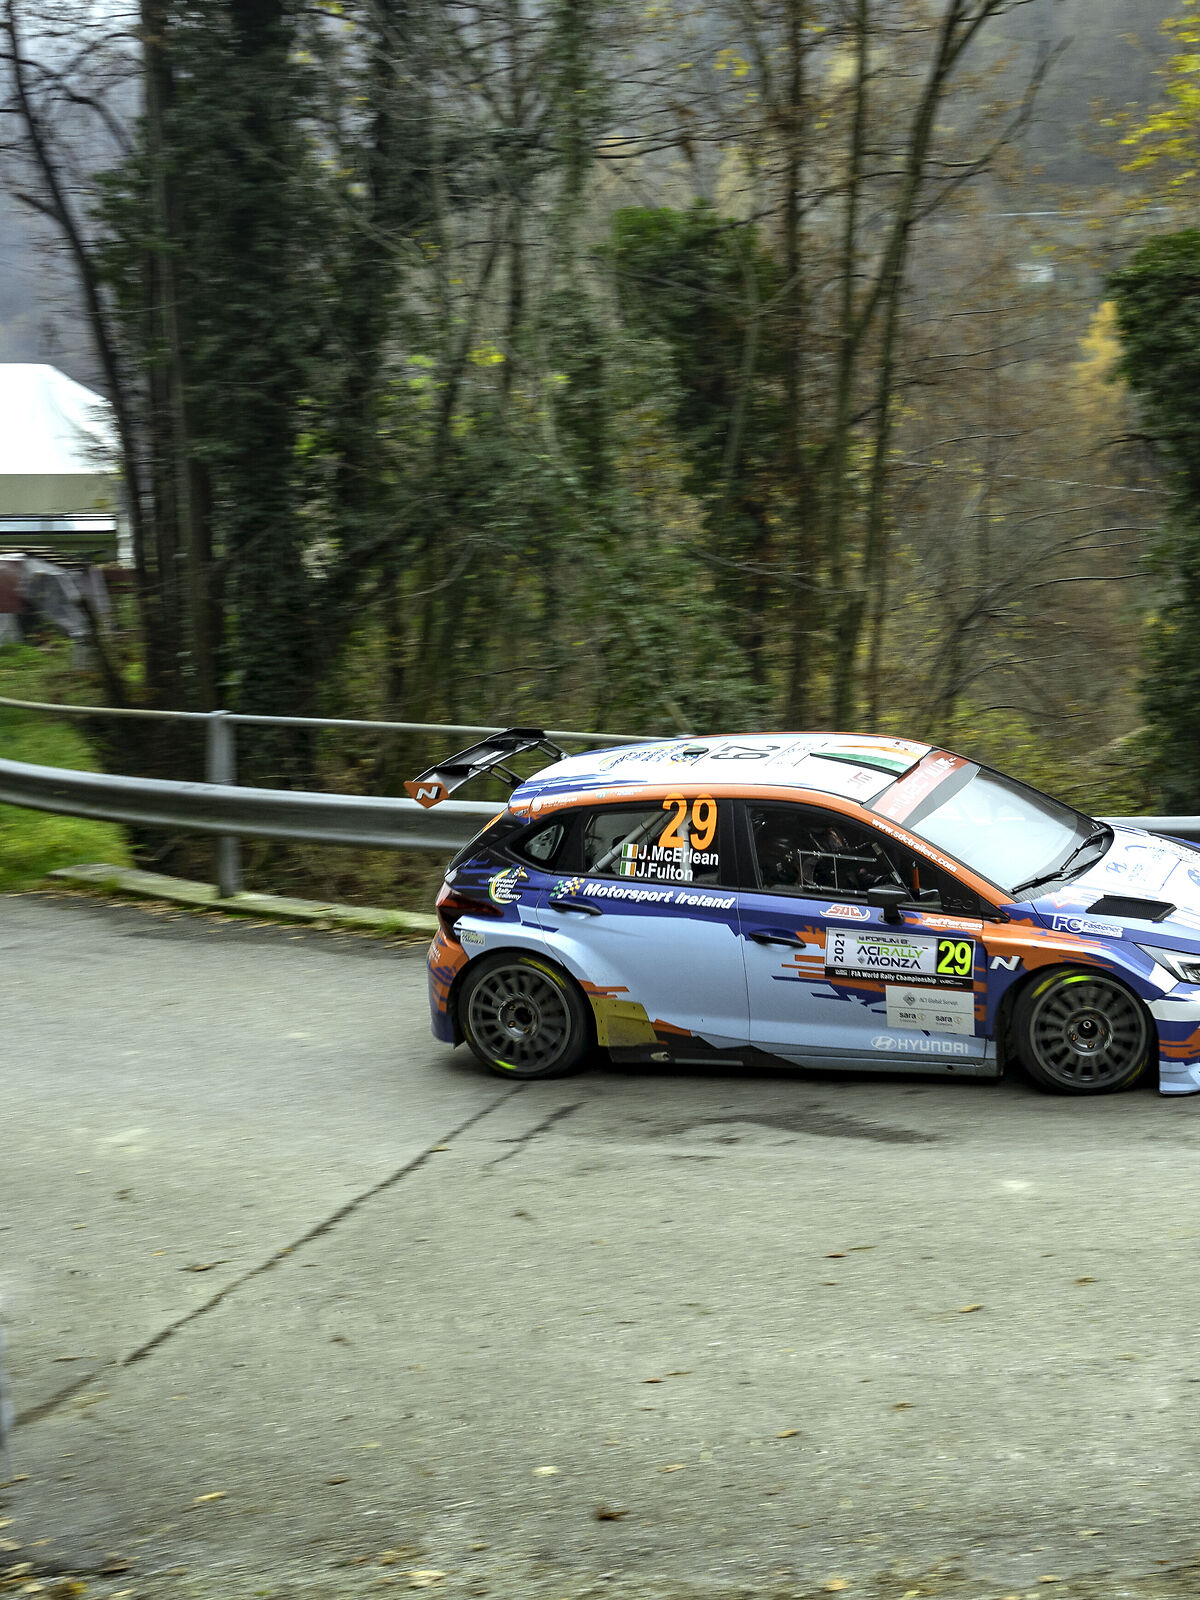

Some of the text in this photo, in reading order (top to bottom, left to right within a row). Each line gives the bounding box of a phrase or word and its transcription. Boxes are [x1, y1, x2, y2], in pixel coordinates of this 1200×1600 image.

[658, 793, 718, 850] 29
[638, 845, 719, 866] J.McErlean
[872, 818, 957, 873] www.sdctrailers.com
[636, 862, 693, 882] J.Fulton
[583, 883, 735, 909] Motorsport Ireland
[1083, 922, 1121, 932] Fastener
[834, 933, 845, 963] 2021
[937, 940, 972, 976] 29
[867, 957, 921, 970] MONZA
[862, 972, 879, 980] World
[880, 973, 895, 982] Rally
[896, 974, 937, 984] Championship
[899, 1012, 917, 1020] sara
[936, 1015, 953, 1023] sara
[898, 1039, 969, 1054] HYUNDAI
